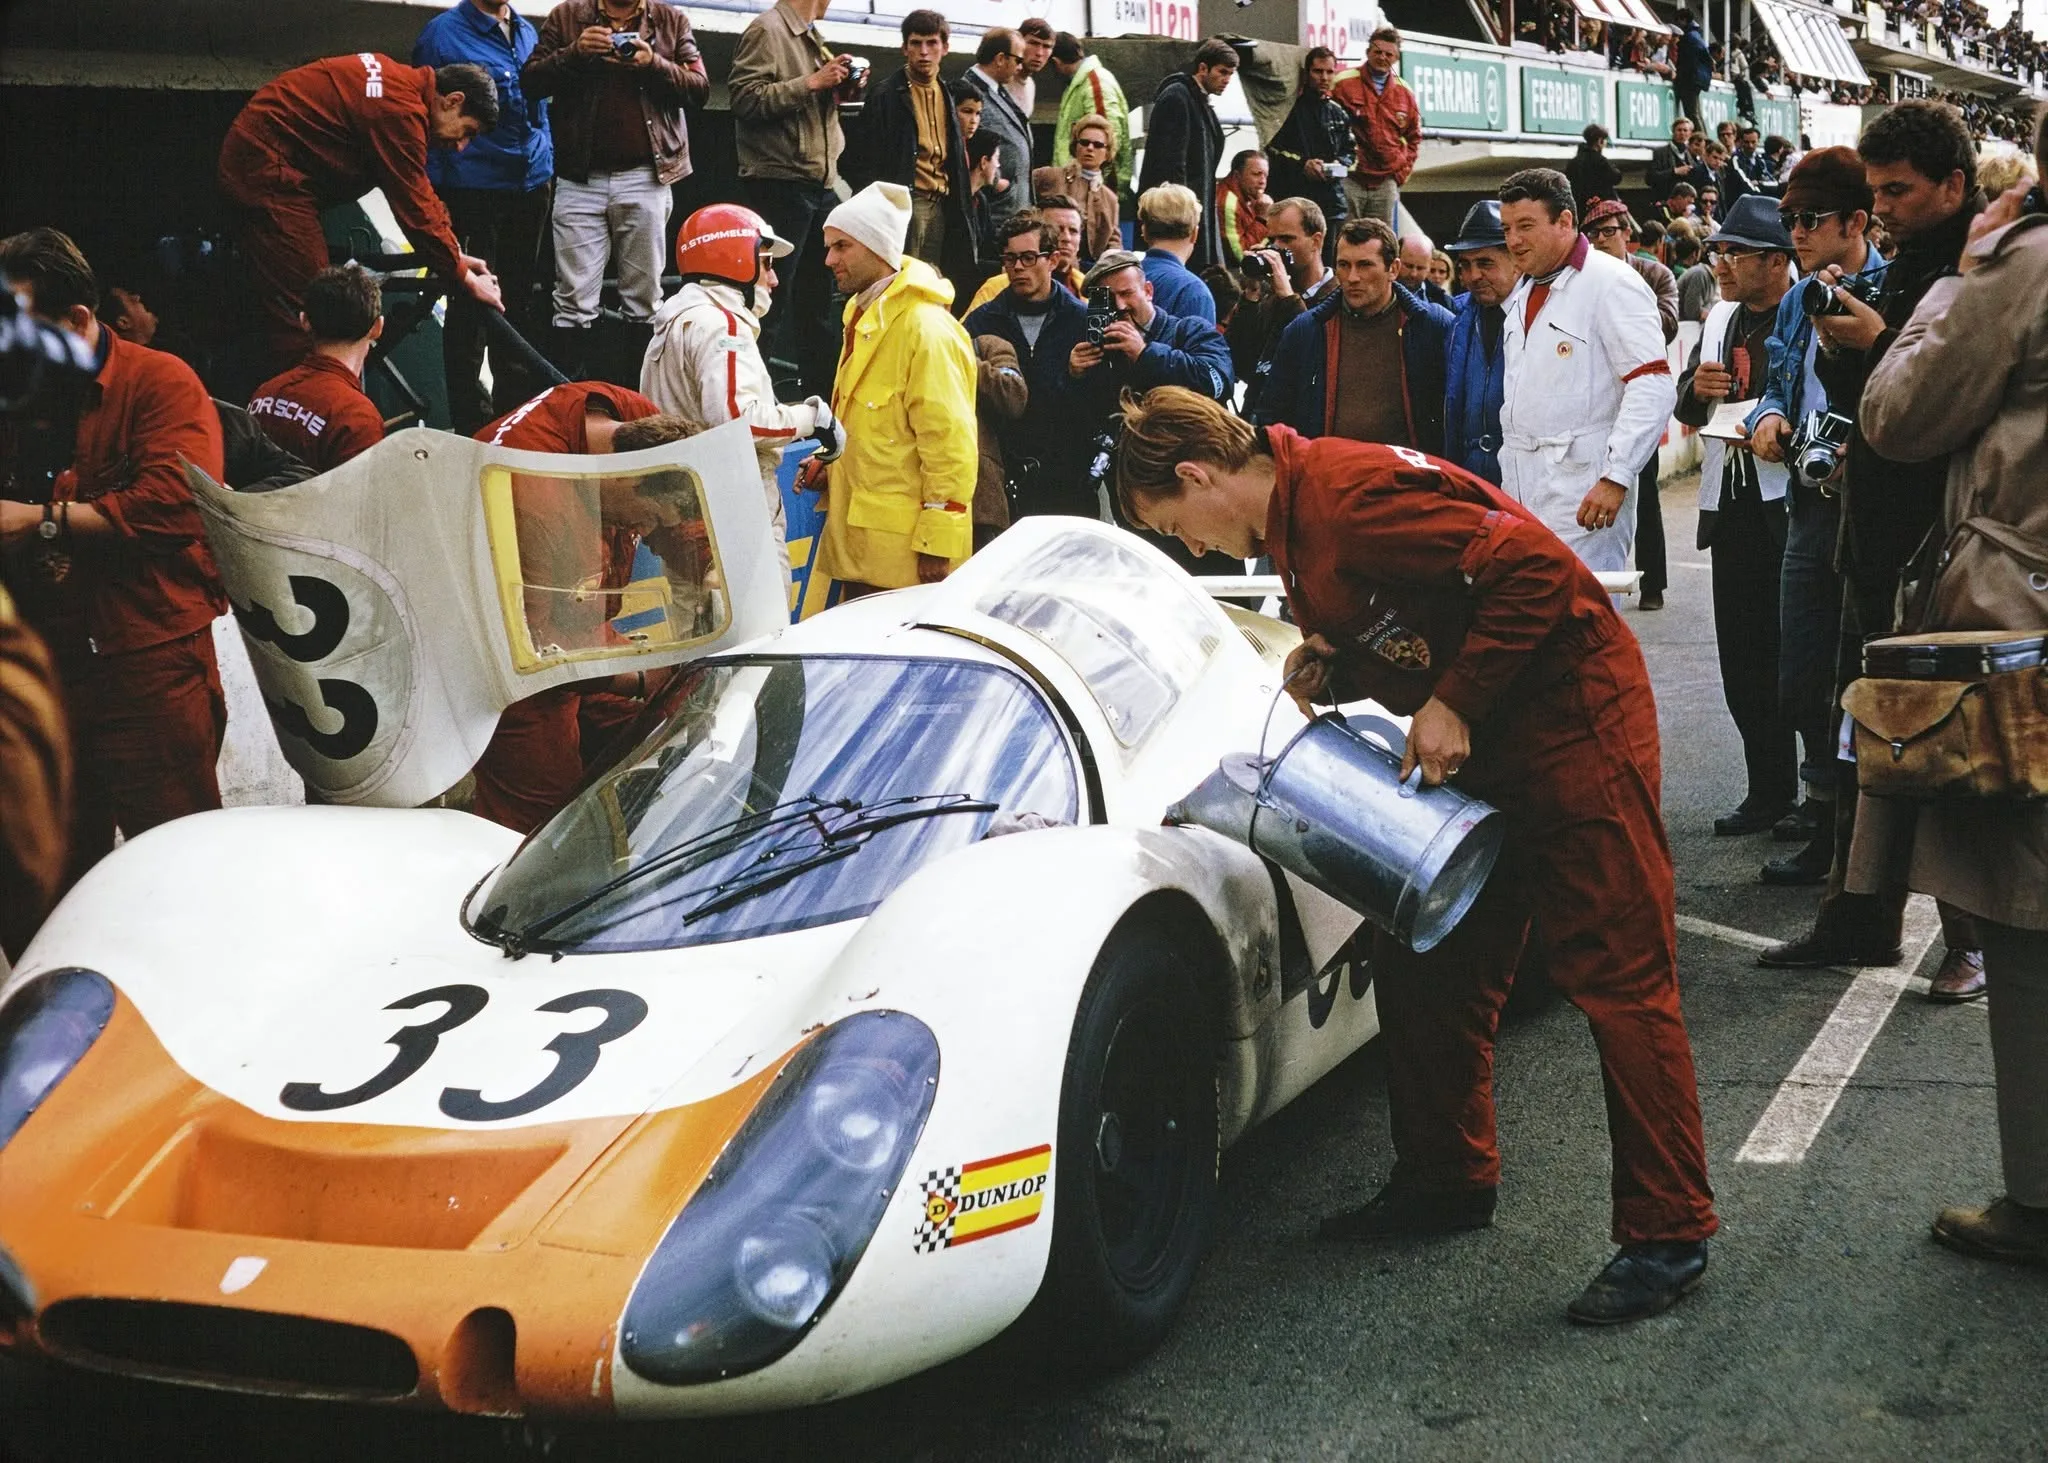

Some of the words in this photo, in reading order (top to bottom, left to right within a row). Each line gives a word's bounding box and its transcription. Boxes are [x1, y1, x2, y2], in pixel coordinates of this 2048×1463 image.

[1413, 65, 1480, 115] FERRARI
[1532, 78, 1583, 121] FERRARI
[1630, 91, 1660, 129] FORD
[279, 983, 649, 1122] 33
[959, 1174, 1048, 1214] DUNLOP
